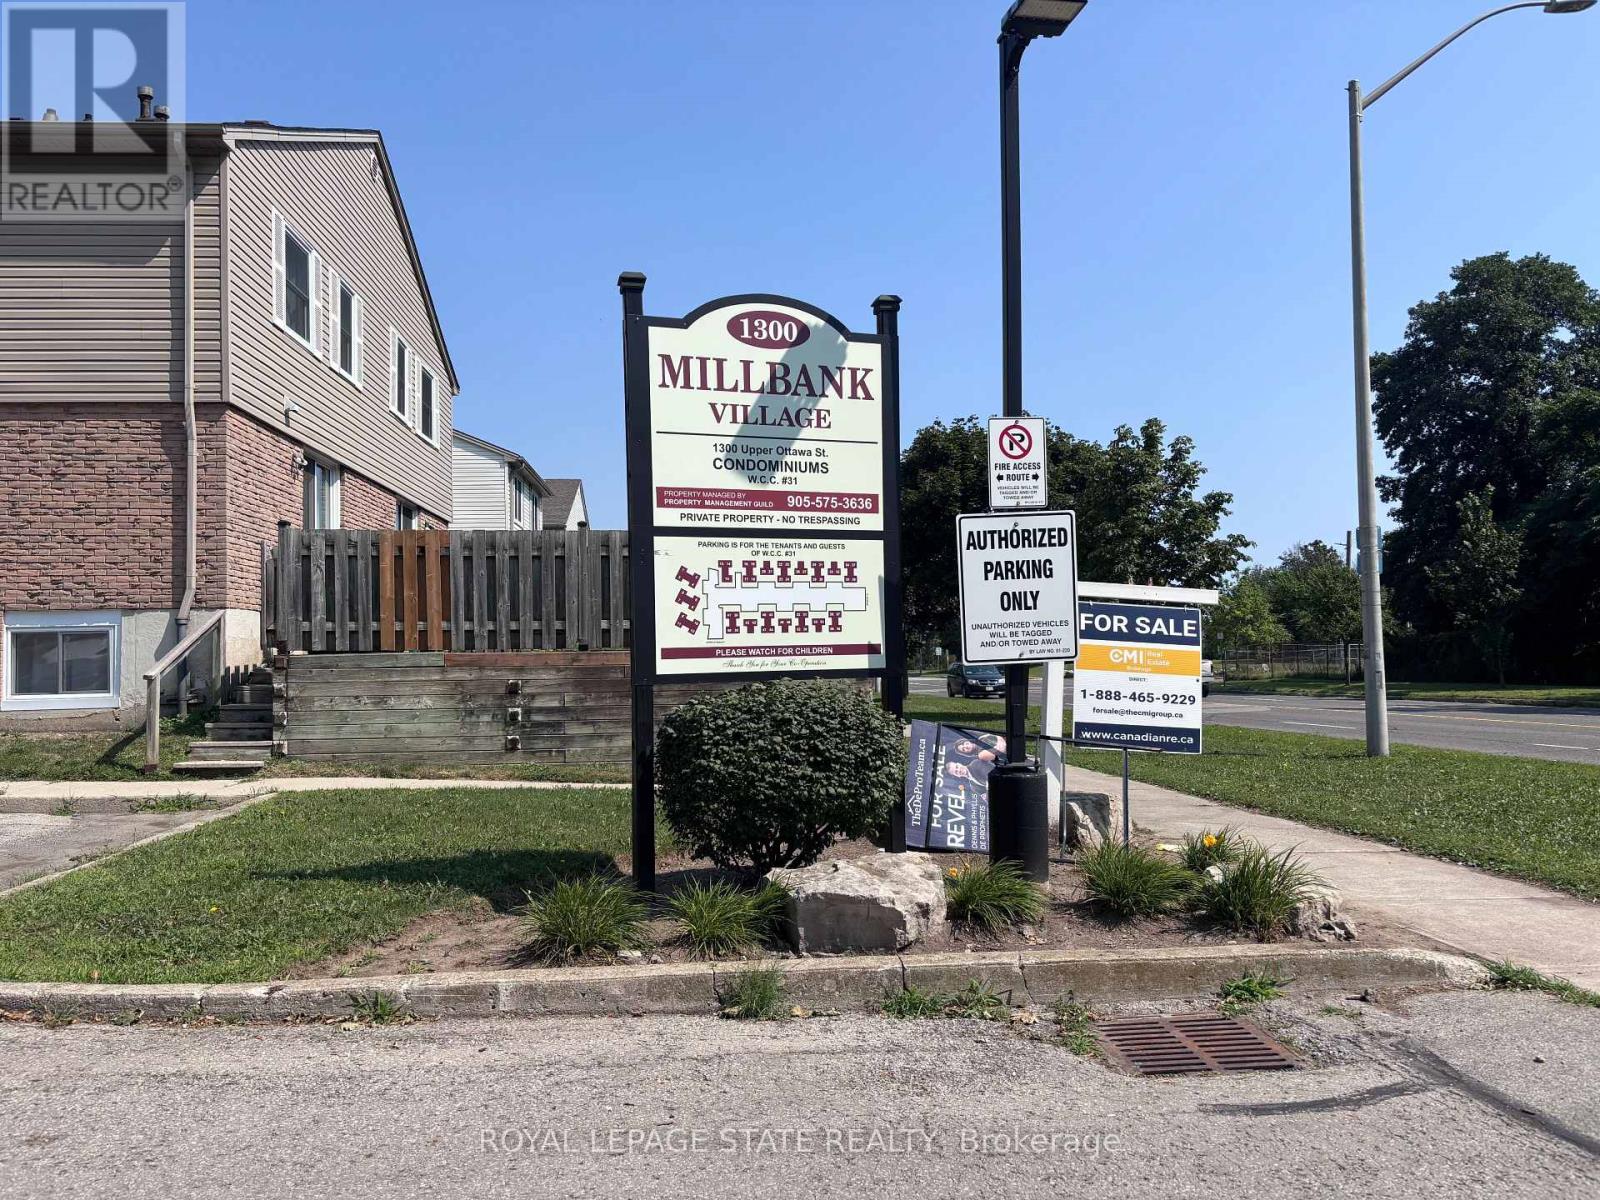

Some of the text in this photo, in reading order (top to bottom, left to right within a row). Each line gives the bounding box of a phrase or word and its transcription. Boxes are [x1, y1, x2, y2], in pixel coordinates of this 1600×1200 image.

[740, 318, 797, 342] 1300
[657, 354, 874, 401] MILLBANK
[708, 402, 831, 429] VILLAGE
[713, 443, 829, 458] 1300 Upper Ottawa St.
[713, 457, 829, 474] CONDOMINIUMS
[994, 462, 1041, 471] FIRE ACCESS
[748, 475, 798, 485] W.C.C. #31
[1006, 473, 1030, 481] ROUTE
[664, 490, 701, 498] PROPERTY
[702, 491, 736, 499] MANAGED
[704, 499, 752, 507] MANAGEMENT
[787, 495, 872, 510] 905-575-3636
[680, 513, 721, 522] PRIVATE
[723, 514, 775, 524] PROPERTY
[782, 515, 796, 524] NO
[798, 516, 861, 526] TRESPASSING
[697, 541, 730, 549] PARKING
[731, 541, 738, 549] IS
[771, 542, 802, 550] TENANTS
[966, 527, 1068, 551] AUTHORIZED
[983, 558, 1054, 581] PARKING
[1000, 590, 1040, 612] ONLY
[971, 620, 1069, 631] UNAUTHORIZED VEHICLES
[1080, 612, 1198, 638] FOR SALE
[989, 629, 1052, 639] WILL BE TAGGED
[1012, 639, 1039, 647] TOWED
[1041, 637, 1062, 646] AWAY
[715, 648, 747, 657] PLEASE
[748, 648, 776, 656] WATCH
[795, 647, 833, 655] CHILDREN
[1109, 649, 1143, 664] CMI
[1080, 688, 1196, 706] 1-888-465-9229
[1092, 707, 1184, 720] forsale@thecmigroup.ca
[1081, 729, 1194, 745] www.canadianre.ca
[911, 738, 926, 827] TheDeProTeam.ca
